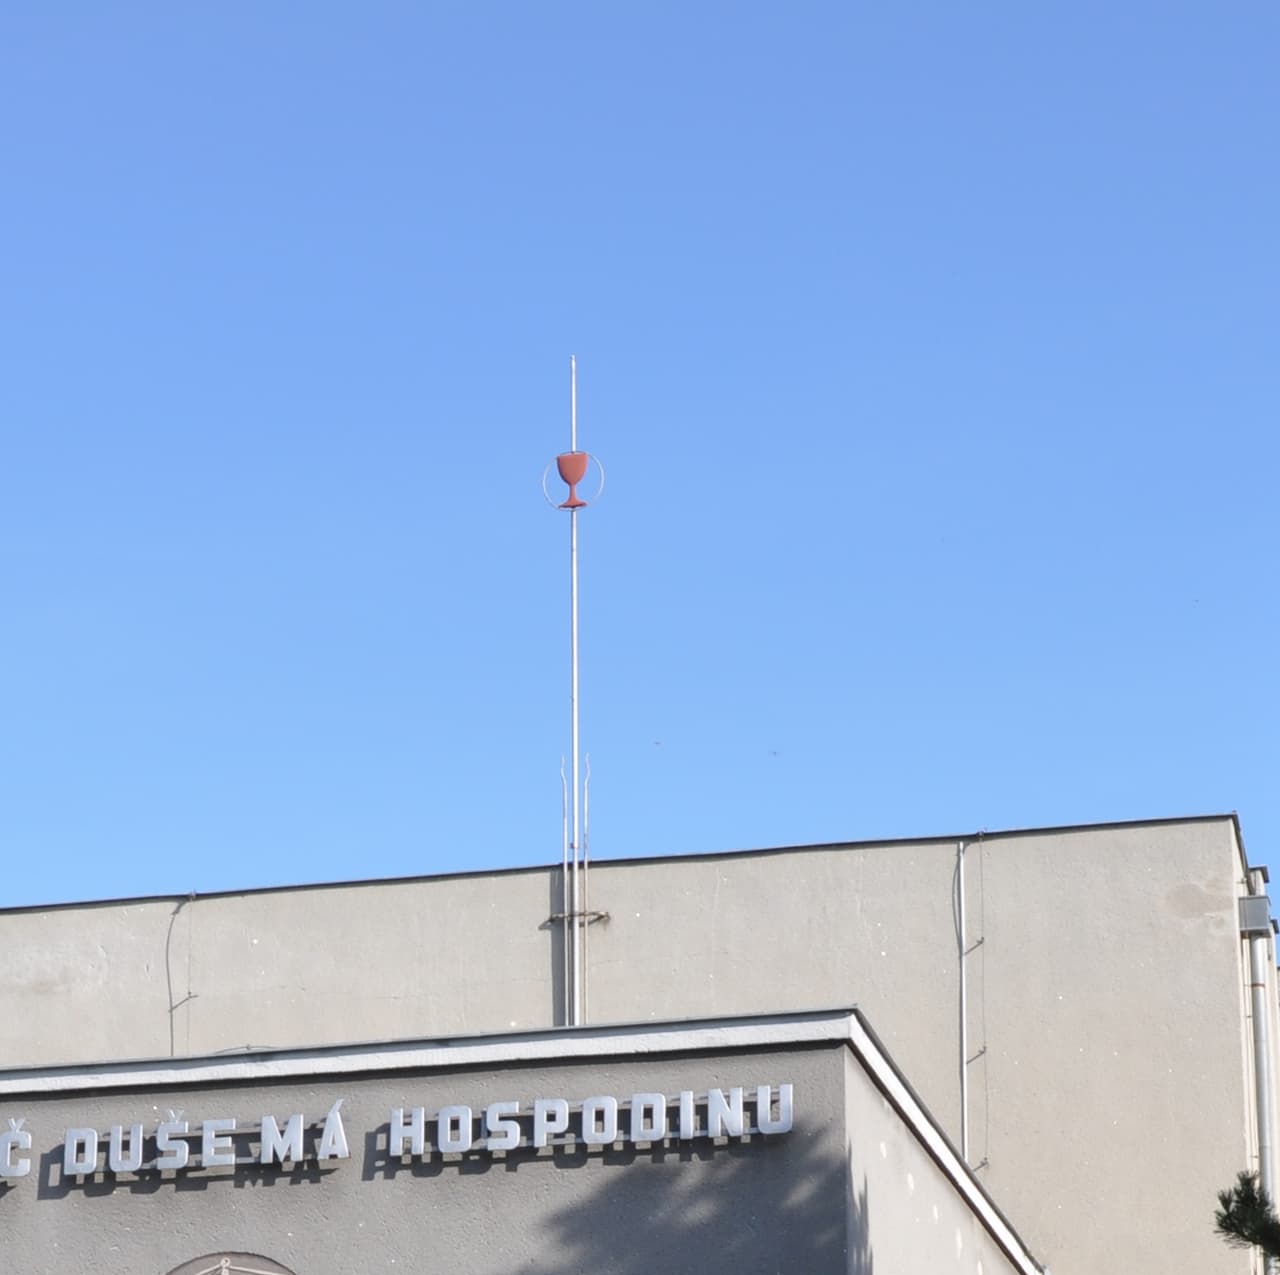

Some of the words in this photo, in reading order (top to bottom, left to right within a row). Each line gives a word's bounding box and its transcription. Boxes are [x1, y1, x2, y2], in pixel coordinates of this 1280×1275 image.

[63, 1109, 237, 1176] DUŠE
[260, 1098, 350, 1164] MÁ
[389, 1083, 794, 1157] HOSPODINU
